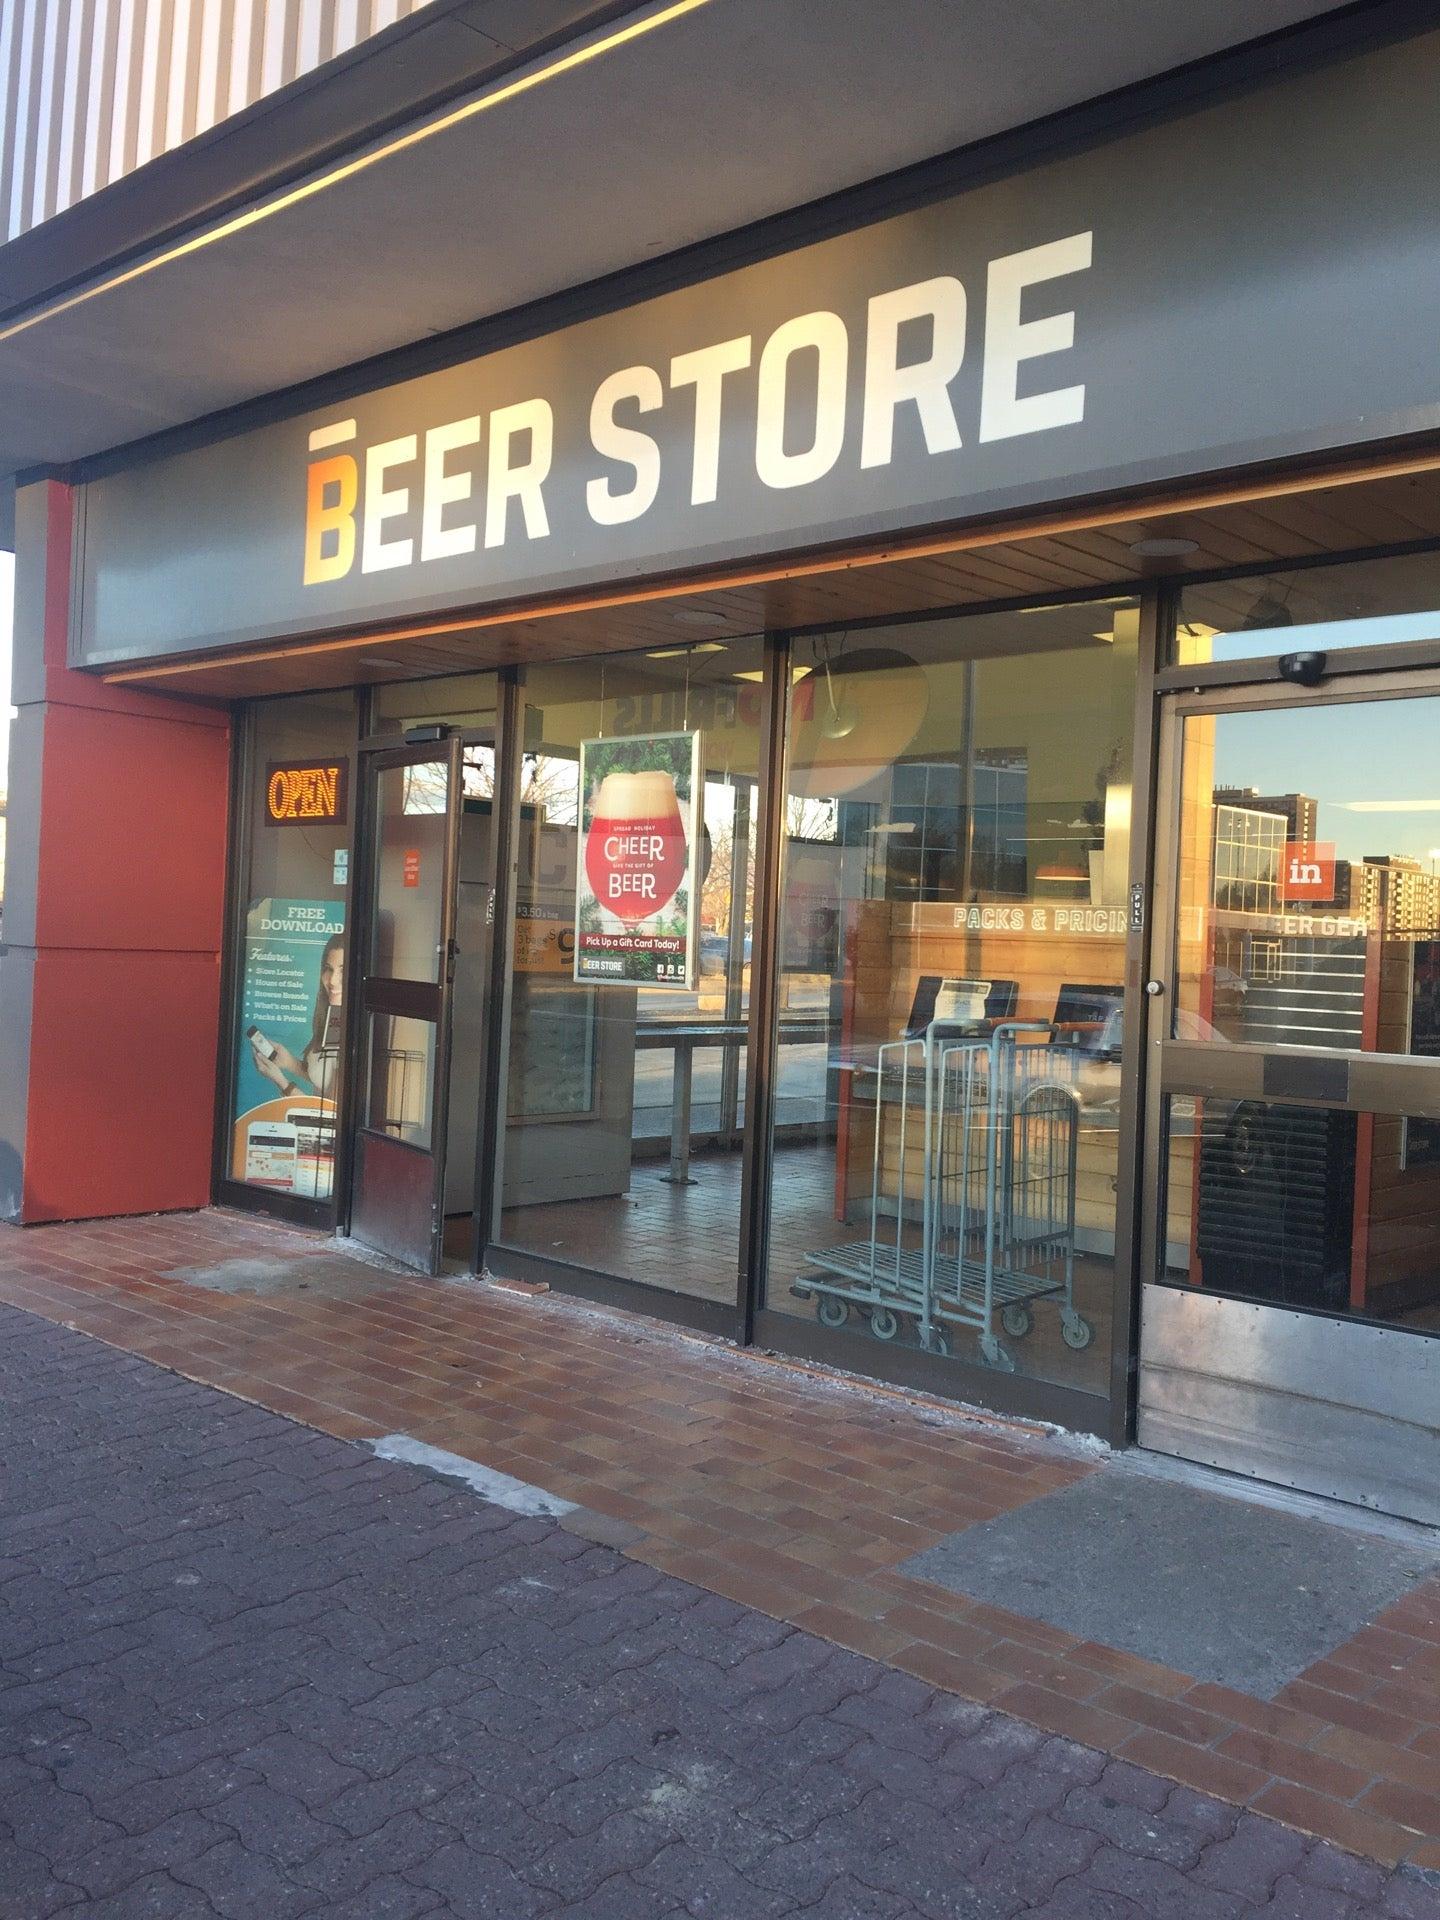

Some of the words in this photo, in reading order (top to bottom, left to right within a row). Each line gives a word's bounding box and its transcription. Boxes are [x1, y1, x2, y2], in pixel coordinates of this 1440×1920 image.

[303, 398, 554, 586] BEER
[586, 230, 1093, 527] STORE
[268, 767, 339, 819] OPEN
[604, 836, 665, 862] CHEER
[1289, 858, 1322, 884] in
[608, 873, 657, 898] BEER
[288, 907, 326, 920] FREE
[954, 908, 1025, 930] PACKS
[1031, 910, 1047, 930] &
[260, 919, 344, 934] DOWNLOAD
[586, 936, 600, 946] Pick
[601, 938, 612, 947] Up
[619, 938, 633, 947] Gift
[634, 938, 652, 948] Card
[654, 939, 680, 950] Today!
[582, 958, 600, 970] BEER
[600, 960, 622, 971] STORE
